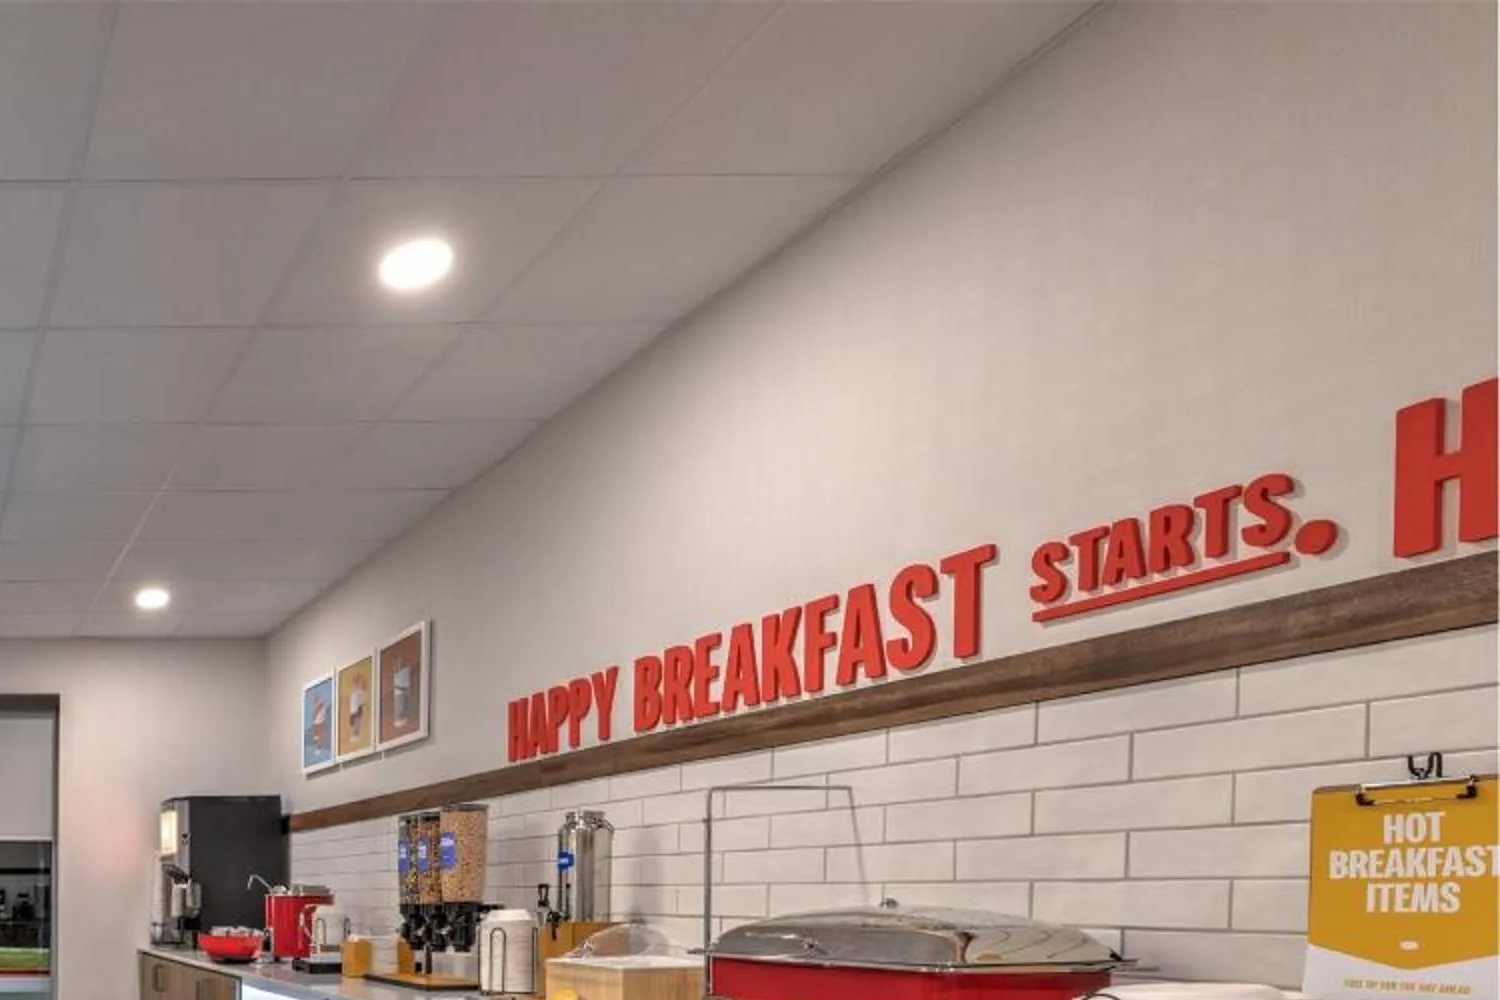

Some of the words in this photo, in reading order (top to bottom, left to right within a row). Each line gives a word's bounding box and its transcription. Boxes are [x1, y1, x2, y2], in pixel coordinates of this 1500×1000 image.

[507, 666, 619, 761] HAPPY
[633, 543, 997, 733] BREAKFAST
[1030, 473, 1338, 602] STARTS.
[1393, 376, 1499, 558] H
[1383, 812, 1445, 844] HOT
[1329, 846, 1499, 880] BREAKFAST
[1366, 882, 1461, 914] ITEMS
